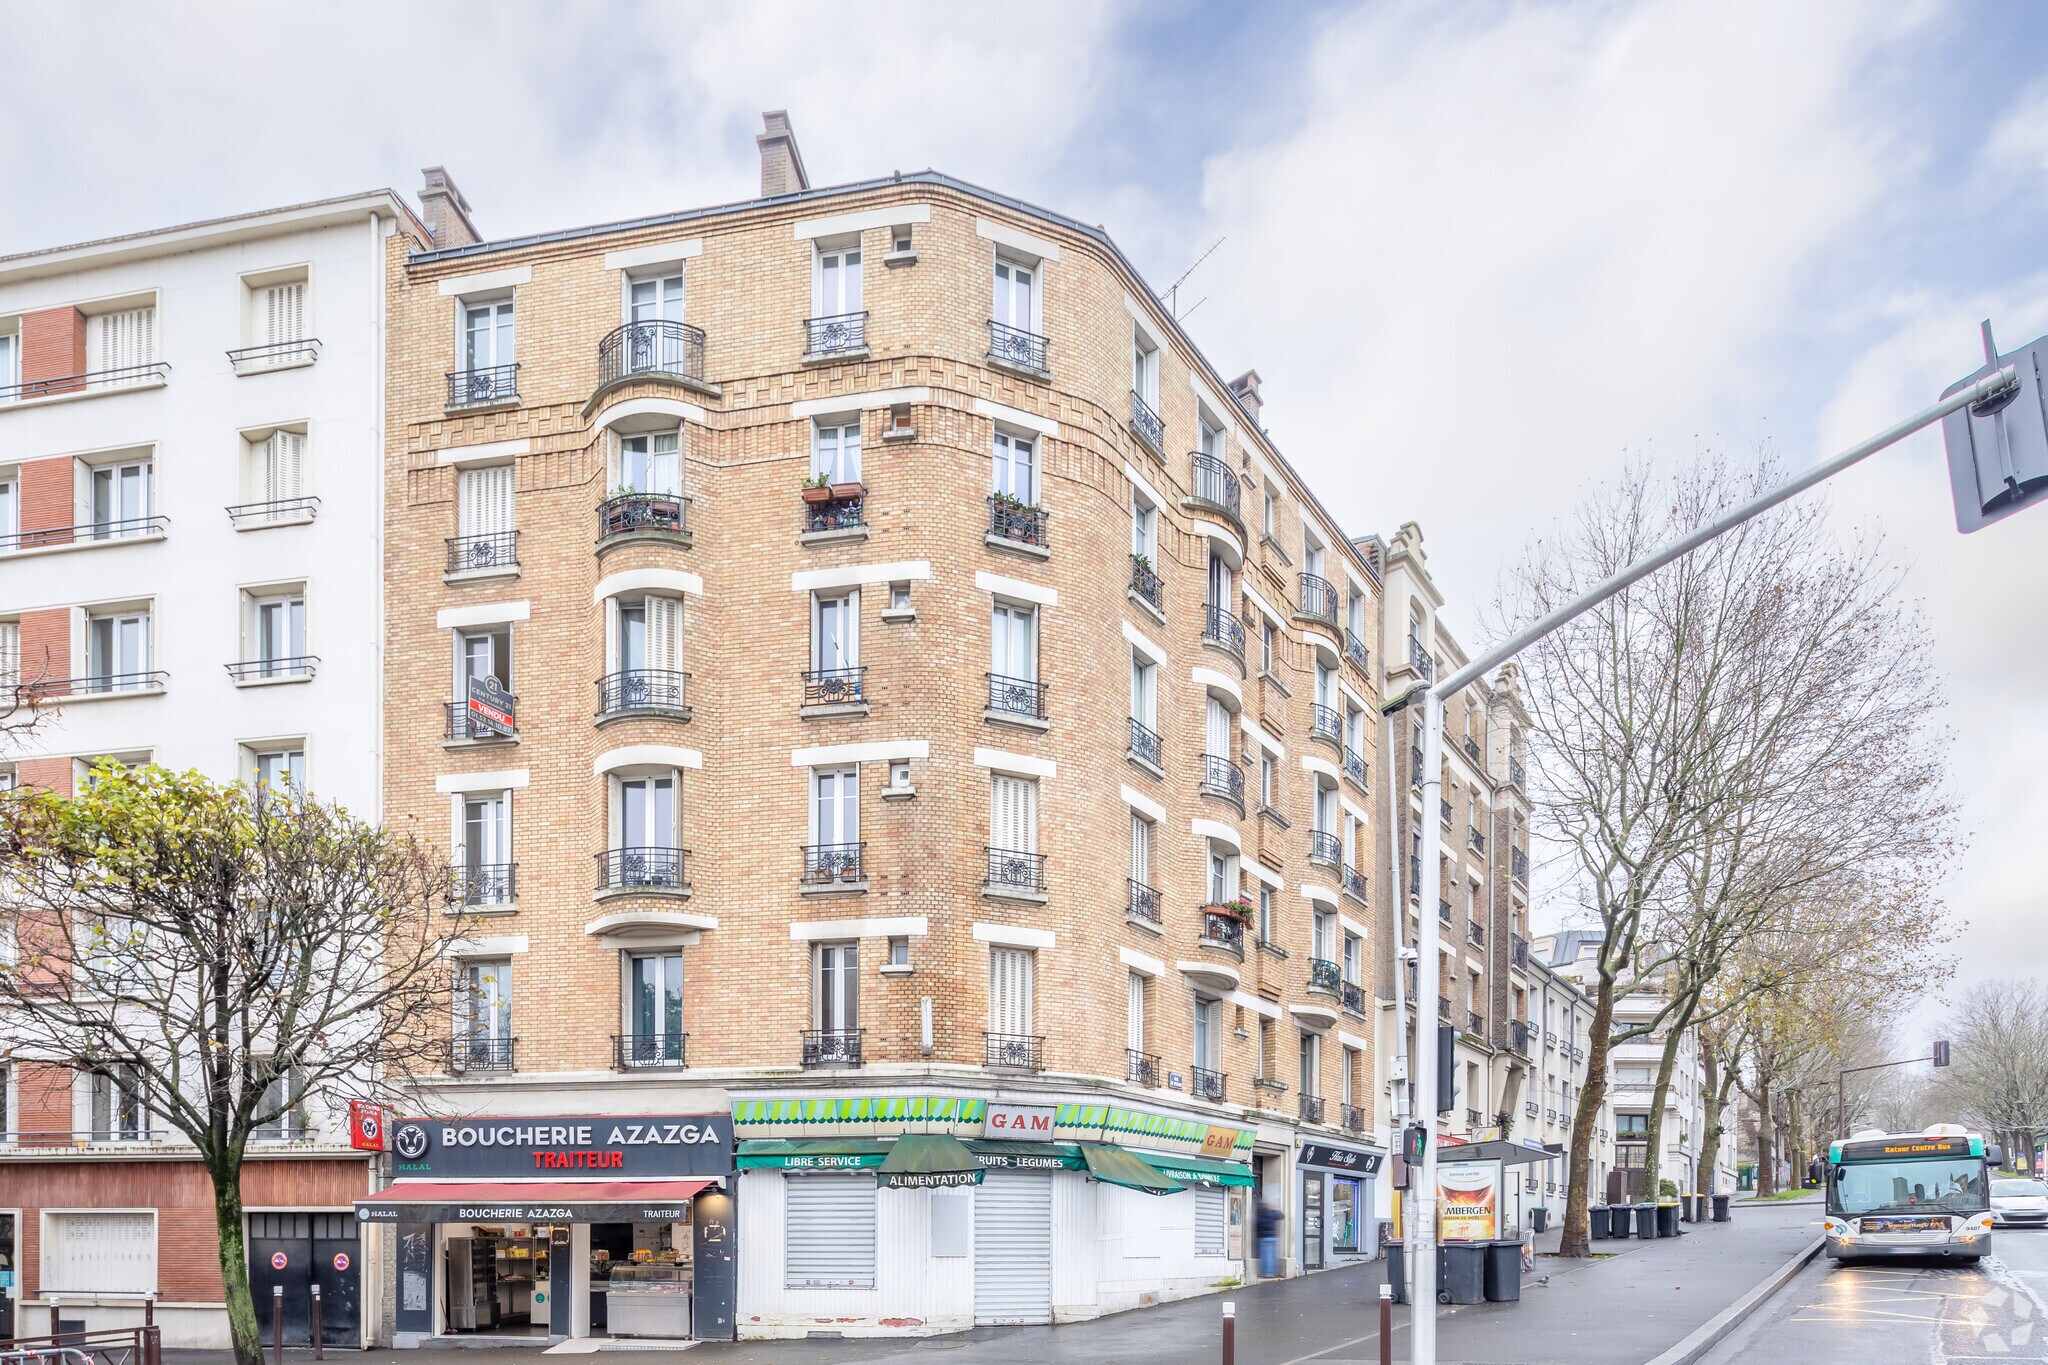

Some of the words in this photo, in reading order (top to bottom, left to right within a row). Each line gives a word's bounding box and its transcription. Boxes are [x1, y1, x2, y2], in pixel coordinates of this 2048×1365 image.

[489, 682, 498, 692] 21
[472, 687, 504, 706] CENTURY
[505, 702, 512, 710] 21
[478, 703, 505, 722] VENDU
[991, 1113, 1050, 1130] GAM
[442, 1126, 592, 1147] BOUCHERIE
[607, 1124, 720, 1145] AZAZGA
[1206, 1134, 1234, 1150] GAM
[532, 1151, 623, 1168] TRAITEUR
[785, 1156, 813, 1166] LIBRE
[817, 1156, 861, 1166] SERVICE
[975, 1155, 1008, 1166] RUITS
[1016, 1157, 1063, 1168] LEGUMES
[398, 1163, 431, 1171] HALAL
[889, 1173, 976, 1187] ALIMENTATION
[459, 1209, 523, 1218] BOUCHERIE
[527, 1209, 573, 1218] AZAZGA
[643, 1210, 680, 1218] TRAITEUR
[1444, 1206, 1491, 1215] MBERGEN
